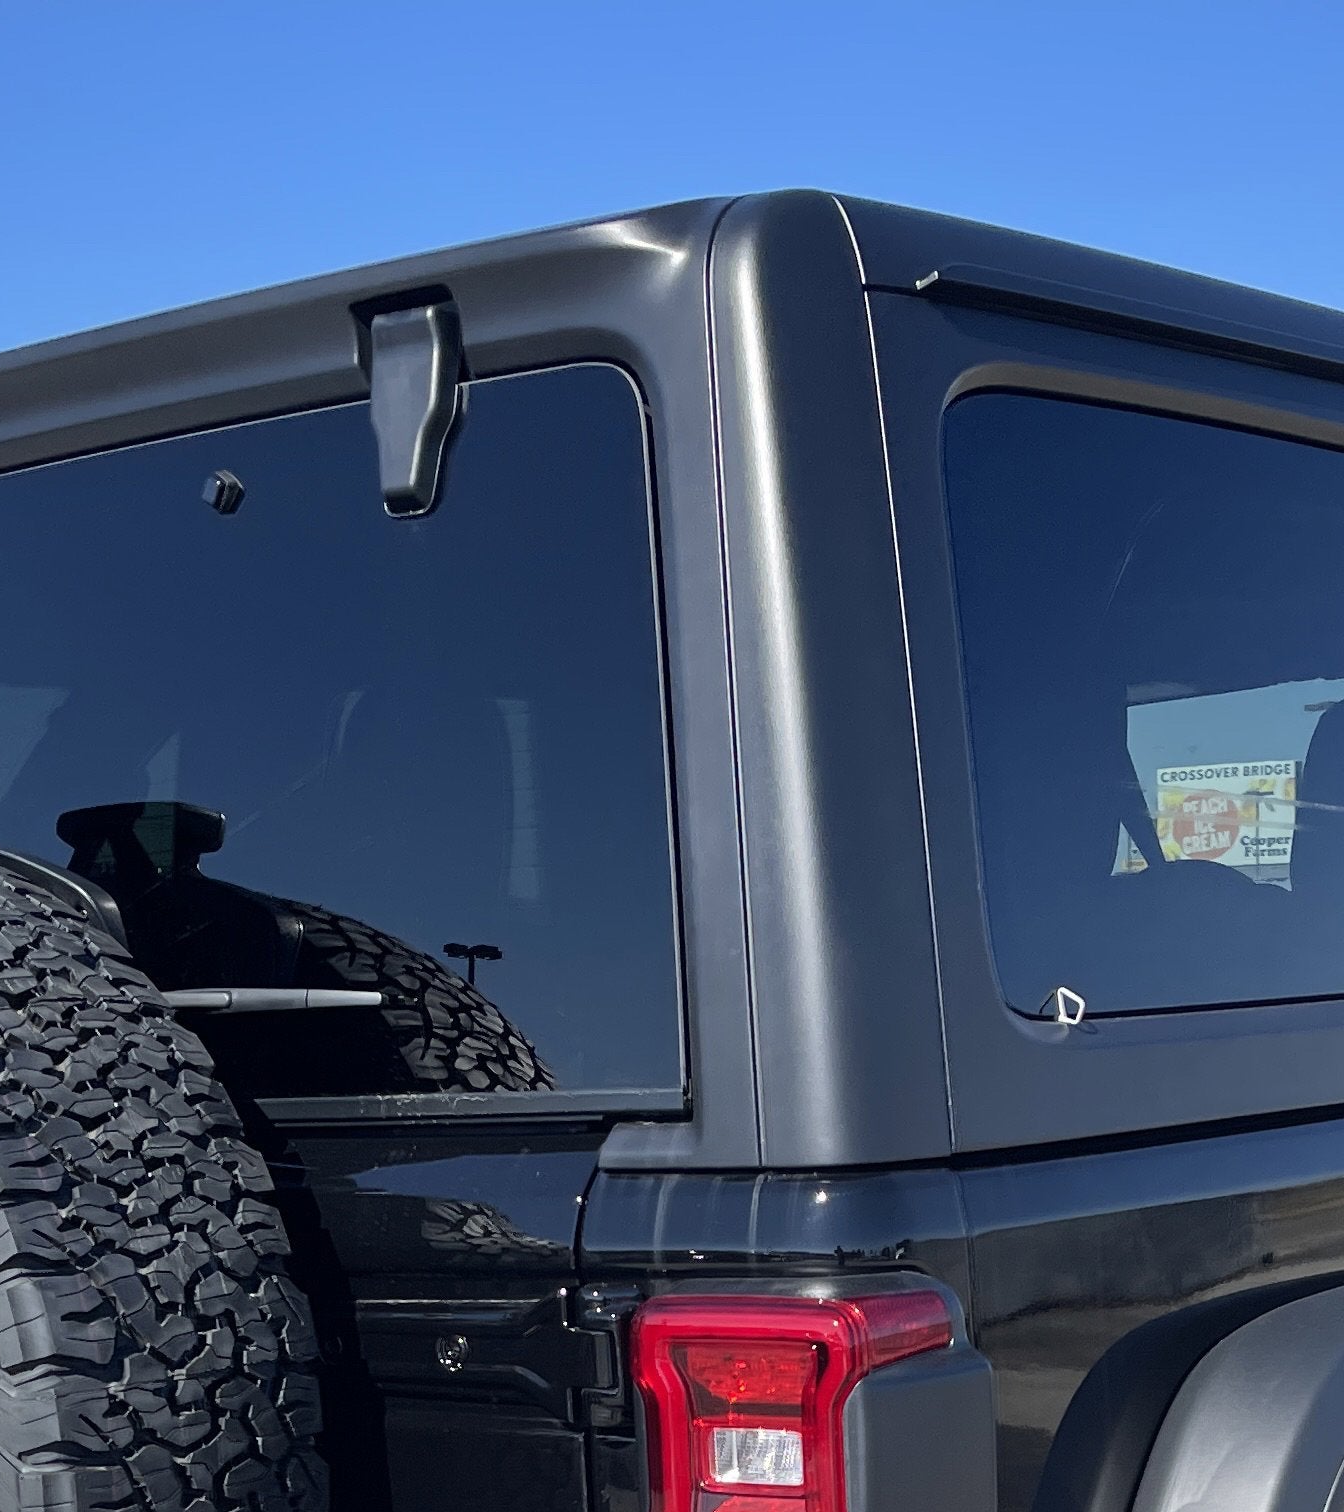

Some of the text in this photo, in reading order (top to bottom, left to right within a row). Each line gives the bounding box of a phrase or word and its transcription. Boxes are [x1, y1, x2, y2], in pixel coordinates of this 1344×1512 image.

[1160, 764, 1291, 783] CROSSOVER BRIDGE
[1182, 796, 1229, 814] PEACH
[1181, 831, 1233, 854] CREAM
[1240, 835, 1292, 848] Cooper
[1244, 846, 1289, 858] Farms
